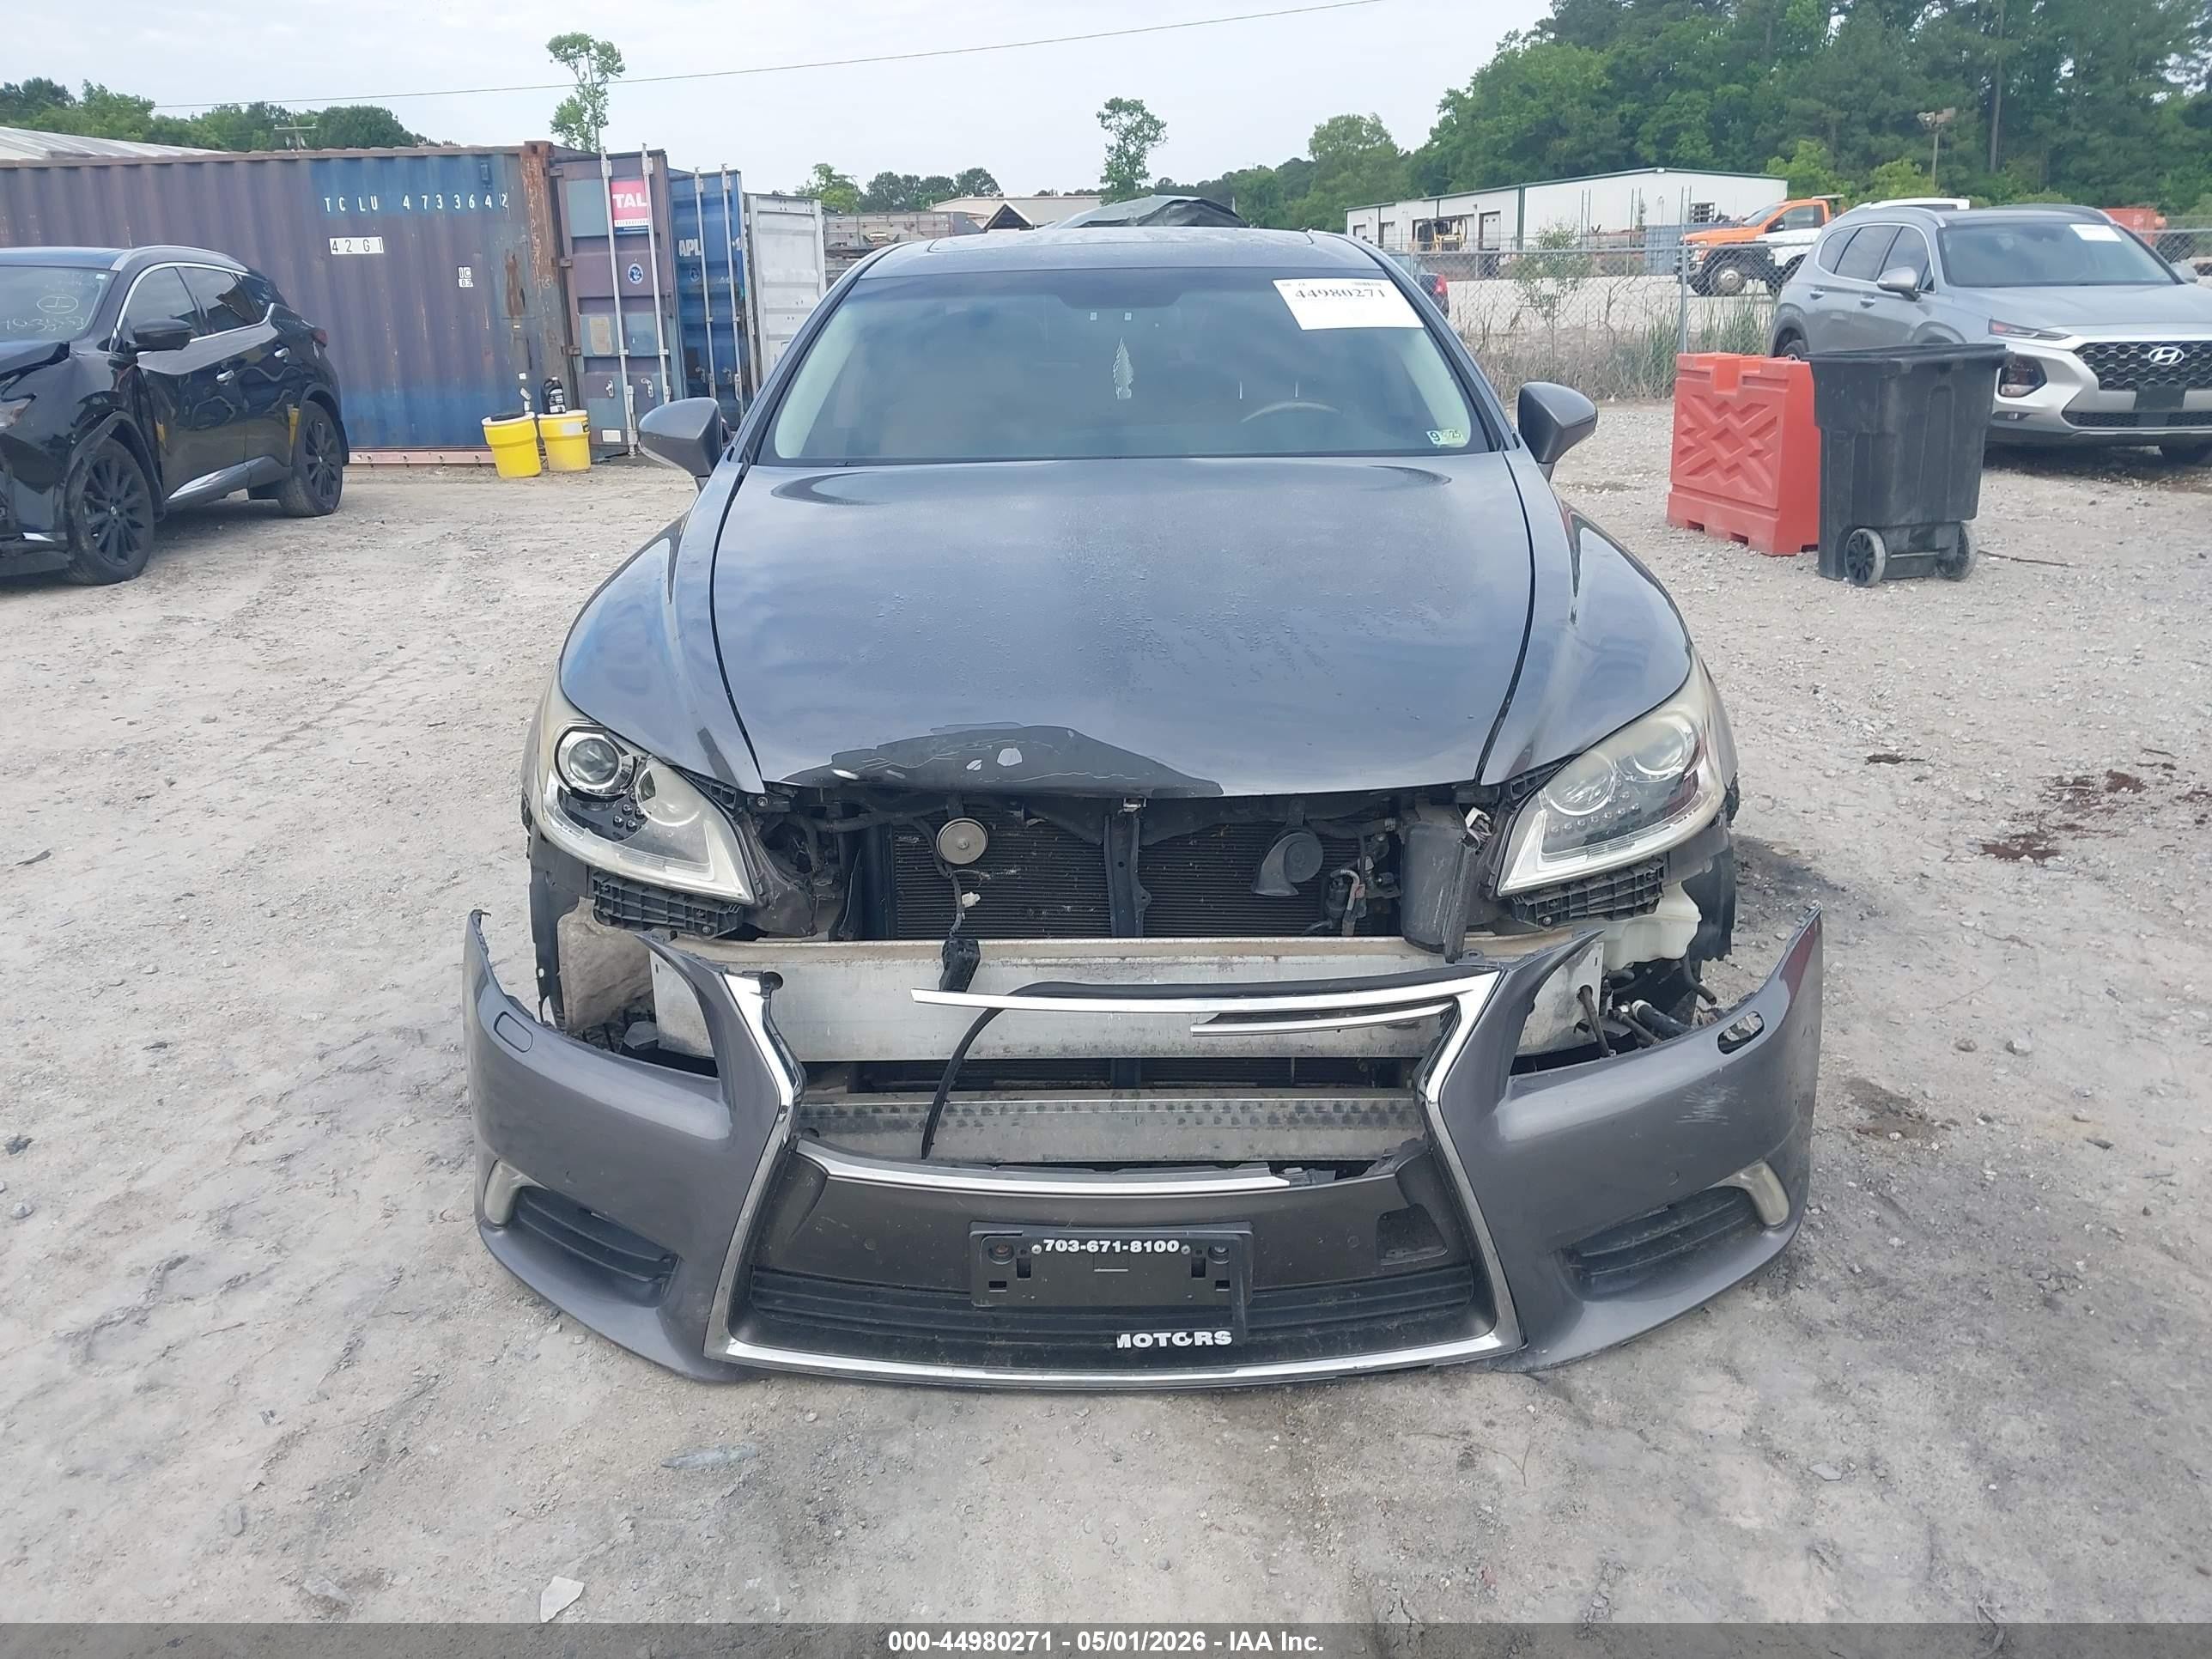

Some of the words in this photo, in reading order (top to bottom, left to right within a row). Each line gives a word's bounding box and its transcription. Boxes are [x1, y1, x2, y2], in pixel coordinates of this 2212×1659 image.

[612, 191, 647, 209] TAL
[678, 239, 701, 257] APL
[1295, 289, 1386, 298] 44980271
[1430, 431, 1440, 441] 9
[1043, 1239, 1180, 1253] 703-671-8100
[1116, 1331, 1232, 1349] MOTORS
